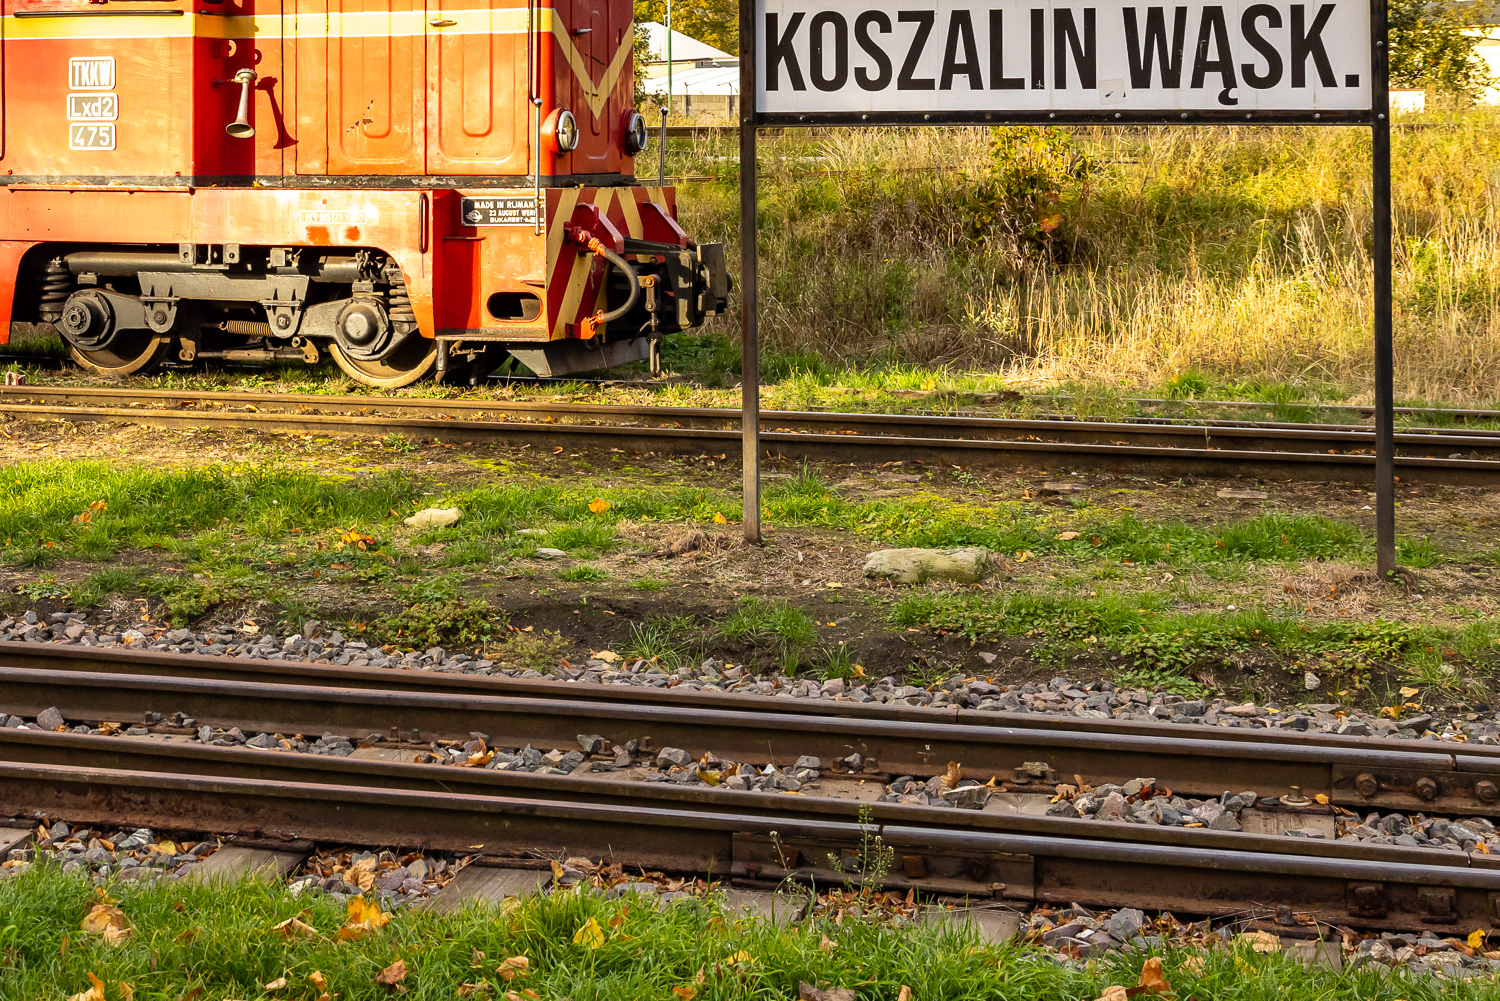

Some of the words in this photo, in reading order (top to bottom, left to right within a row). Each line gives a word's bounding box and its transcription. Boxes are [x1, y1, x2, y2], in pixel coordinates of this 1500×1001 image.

[766, 7, 1097, 92] KOSZALIN
[1122, 3, 1360, 106] WĄSK.
[72, 61, 111, 87] TKKW
[71, 97, 113, 117] Lxd2
[74, 126, 110, 147] 475
[474, 201, 495, 209] MADE
[496, 201, 505, 209] IN
[498, 209, 520, 217] AUGUST
